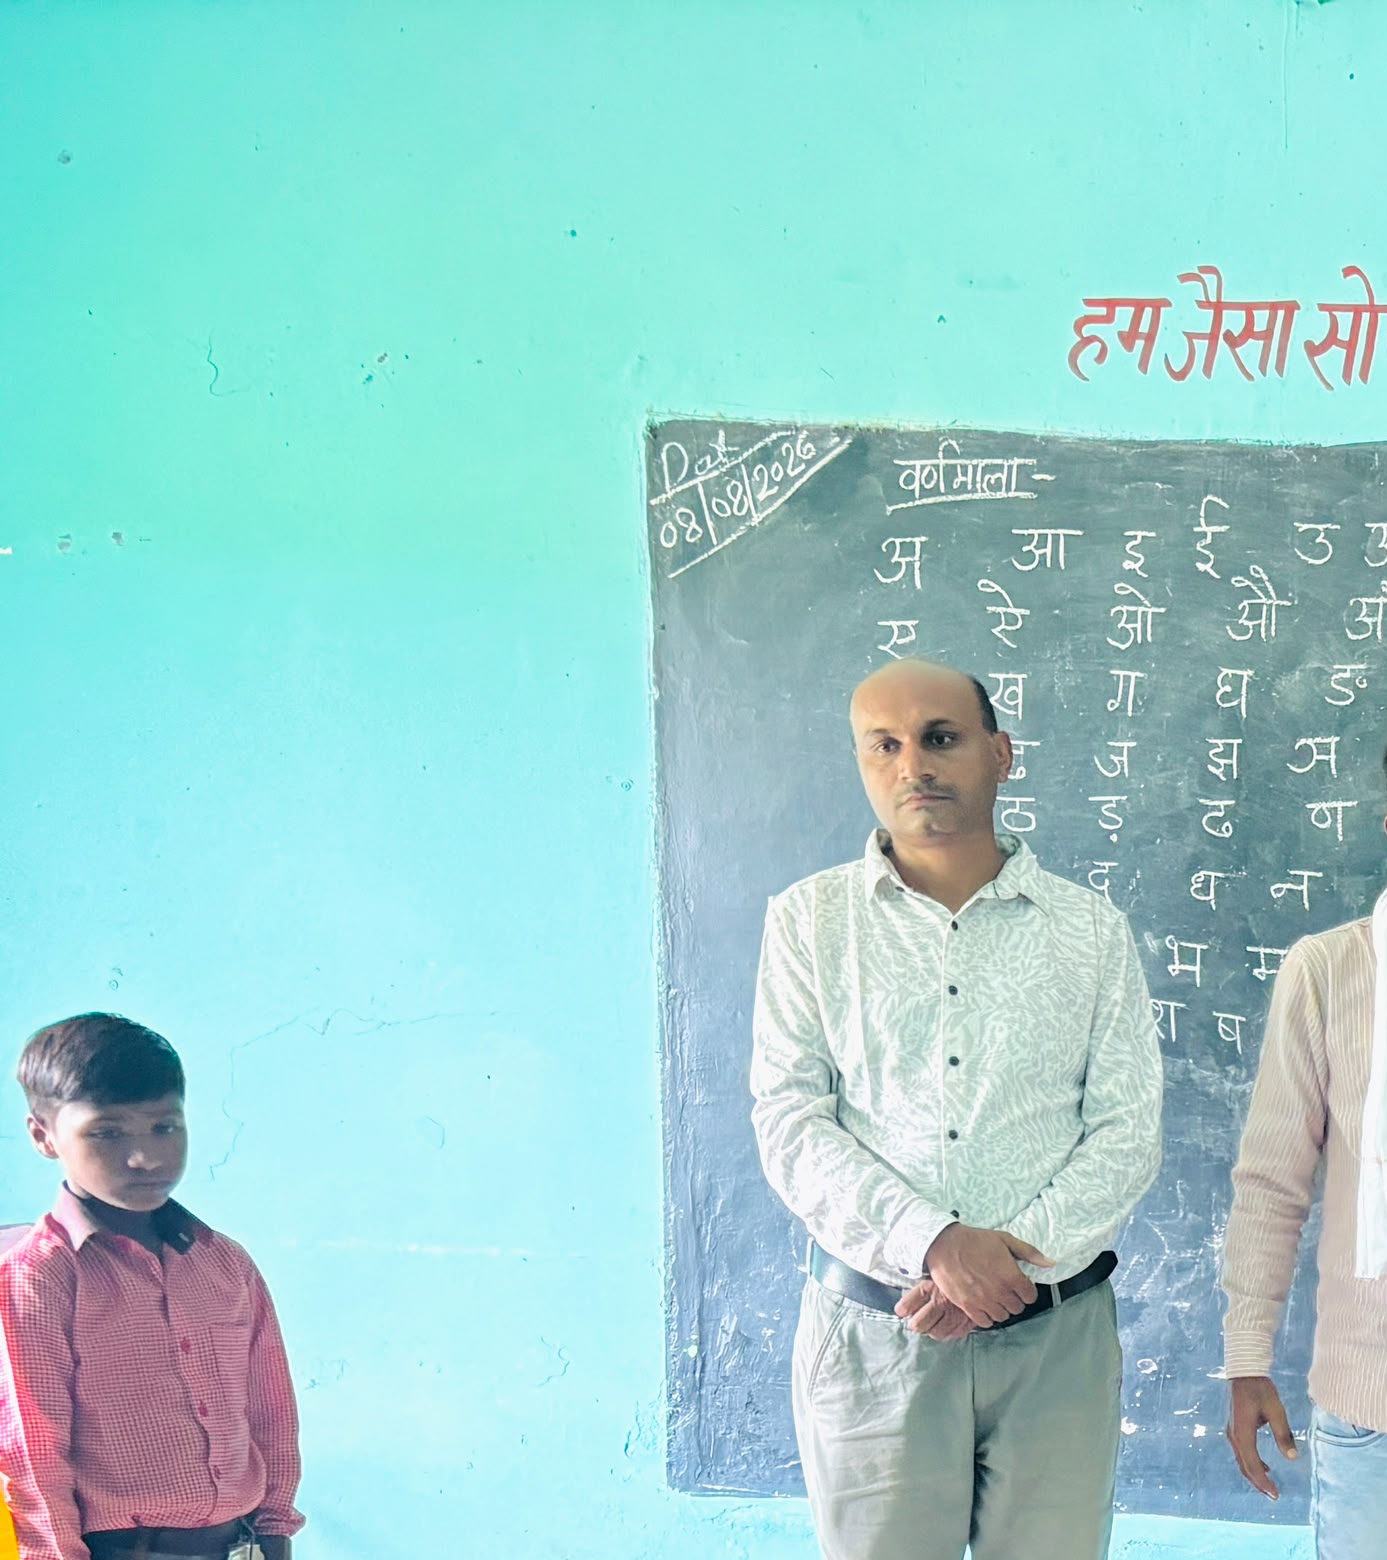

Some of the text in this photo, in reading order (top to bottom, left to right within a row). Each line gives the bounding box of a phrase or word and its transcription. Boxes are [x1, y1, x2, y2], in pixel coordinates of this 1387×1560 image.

[1066, 297, 1171, 384] हम
[1163, 265, 1300, 382] जैसा
[874, 536, 928, 589] अ
[1010, 528, 1084, 571] आ
[1122, 529, 1156, 578] इ
[1192, 494, 1231, 579] ई
[1293, 521, 1341, 565] उ
[1106, 582, 1167, 650] ओ
[1225, 565, 1292, 642] औ
[988, 673, 1028, 721] ख
[1106, 669, 1145, 718] ग
[1094, 740, 1137, 779] ज
